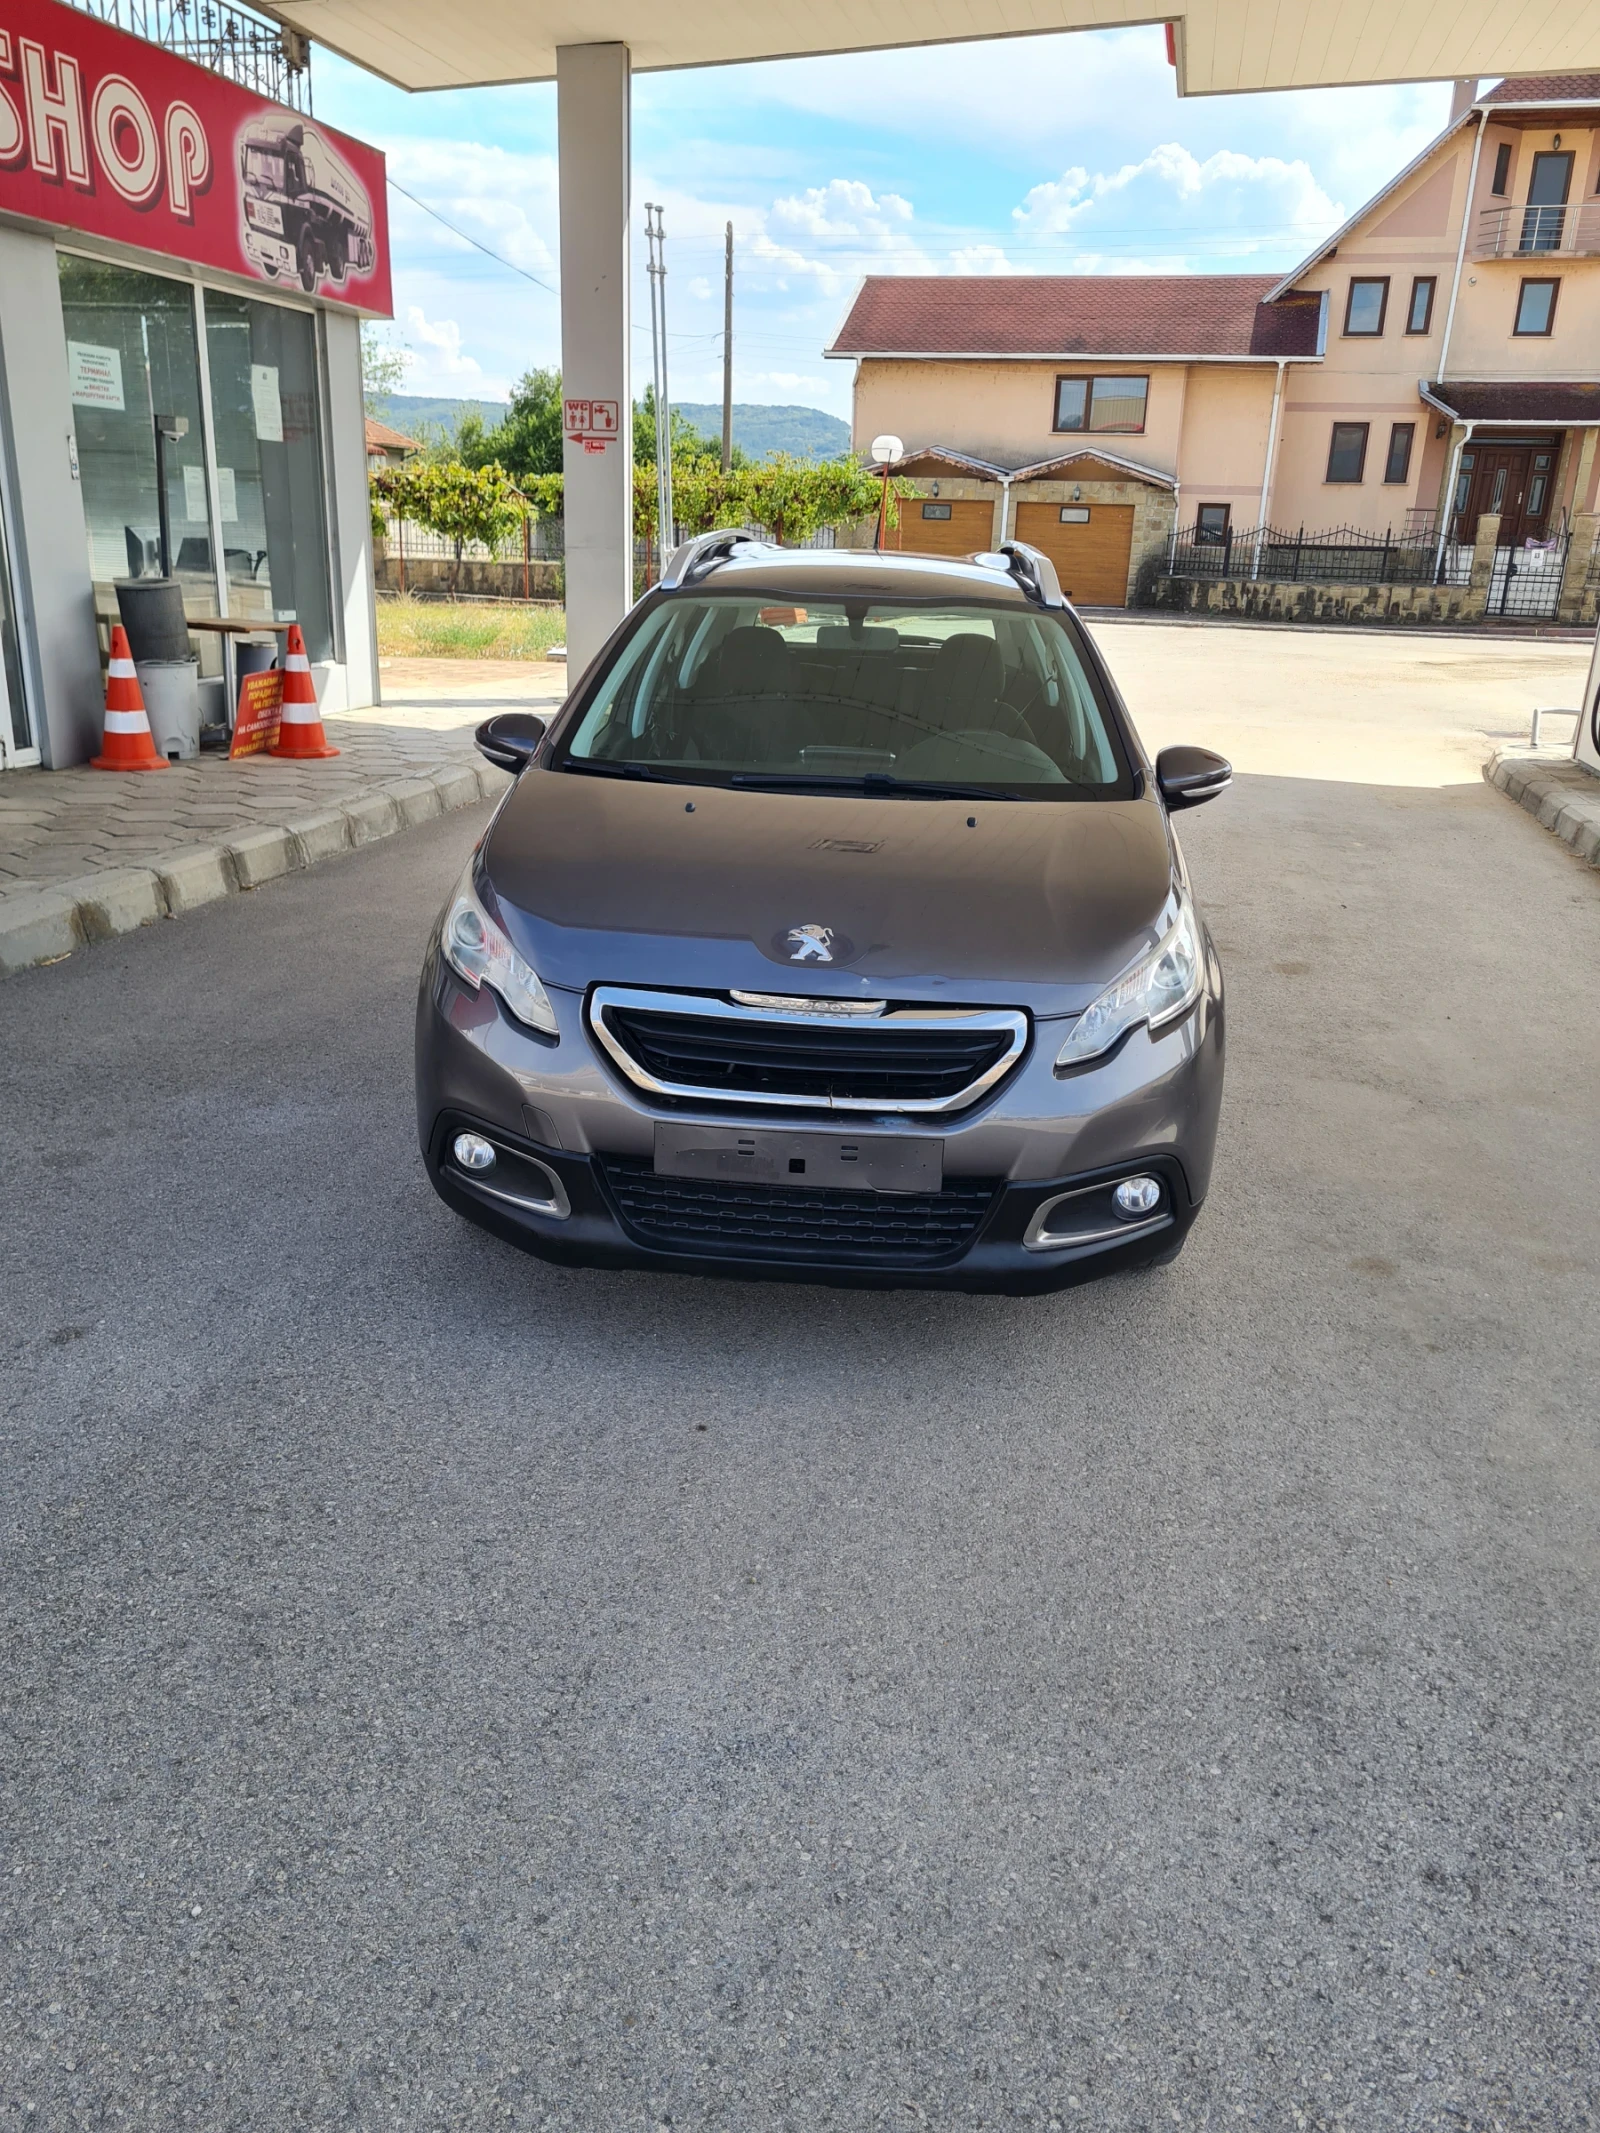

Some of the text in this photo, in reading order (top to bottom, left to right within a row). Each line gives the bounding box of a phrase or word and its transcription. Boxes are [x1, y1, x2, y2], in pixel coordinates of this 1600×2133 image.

[80, 365, 111, 378] ТЕРМИНАЛ
[568, 402, 588, 411] WC
[247, 676, 279, 691] УВАЖАЕМИ
[248, 688, 271, 701] ПОРАДИ
[237, 725, 246, 735] НА
